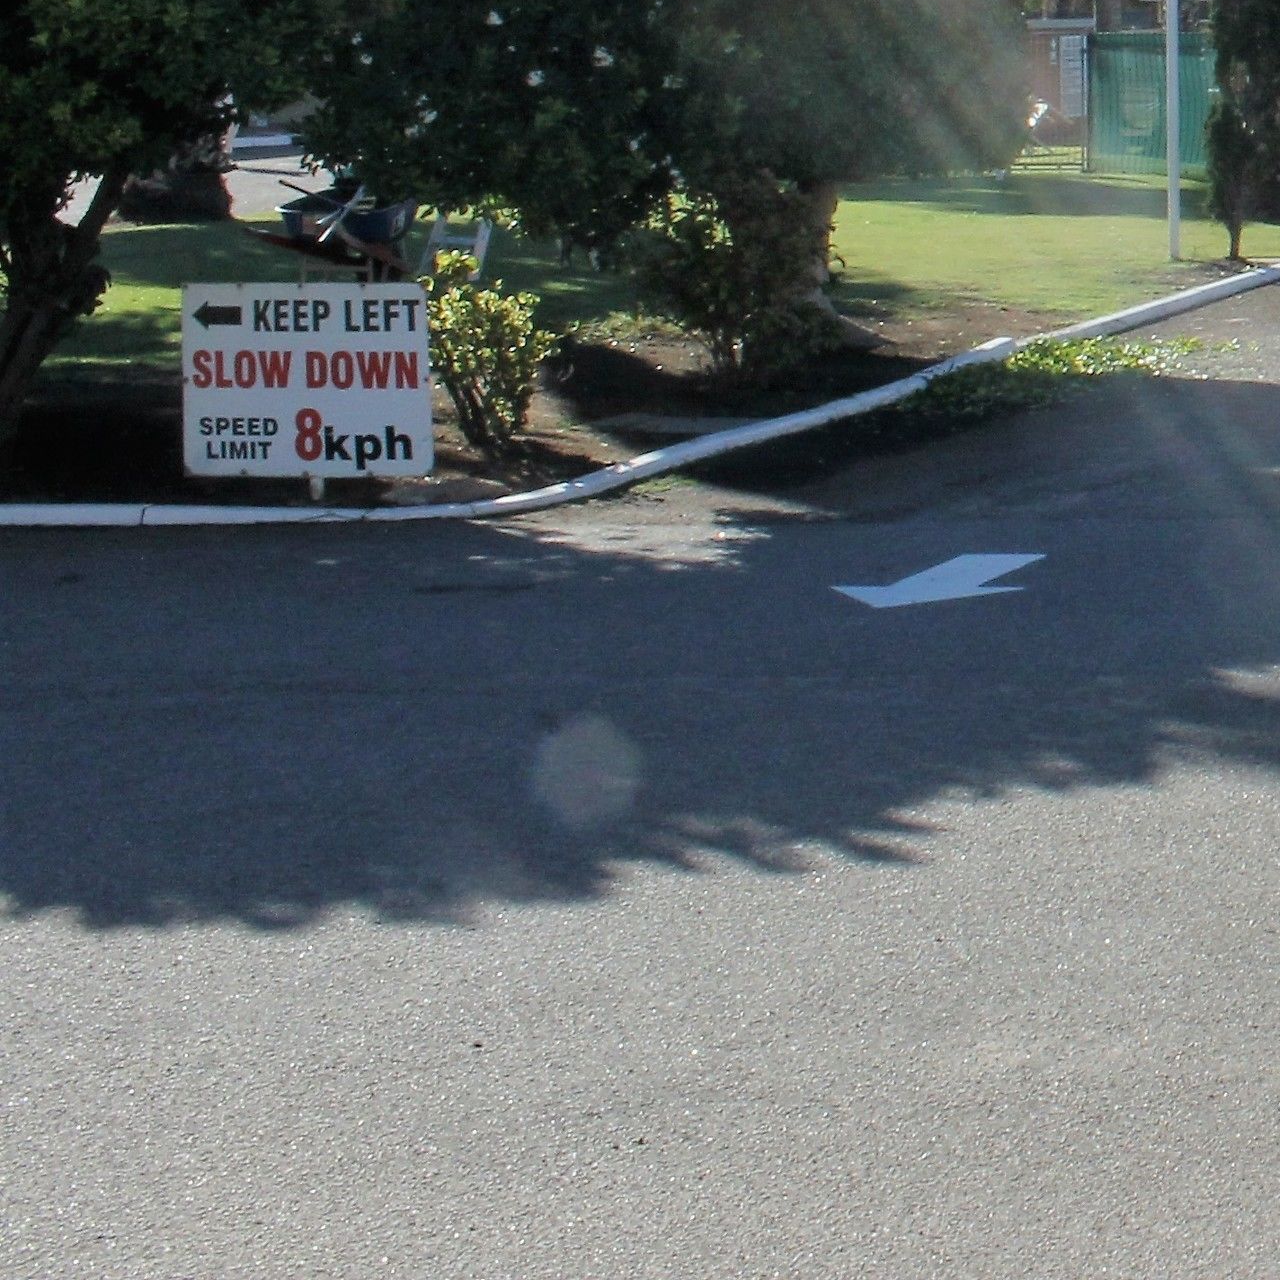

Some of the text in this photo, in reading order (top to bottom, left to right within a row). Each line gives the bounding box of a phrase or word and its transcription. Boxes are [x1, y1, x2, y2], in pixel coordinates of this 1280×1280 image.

[253, 300, 419, 332] KEEP LEFT
[192, 350, 419, 389] SLOW DOWN
[200, 417, 278, 436] SPEED
[295, 408, 413, 470] 8kph
[206, 441, 272, 460] LIMIT
